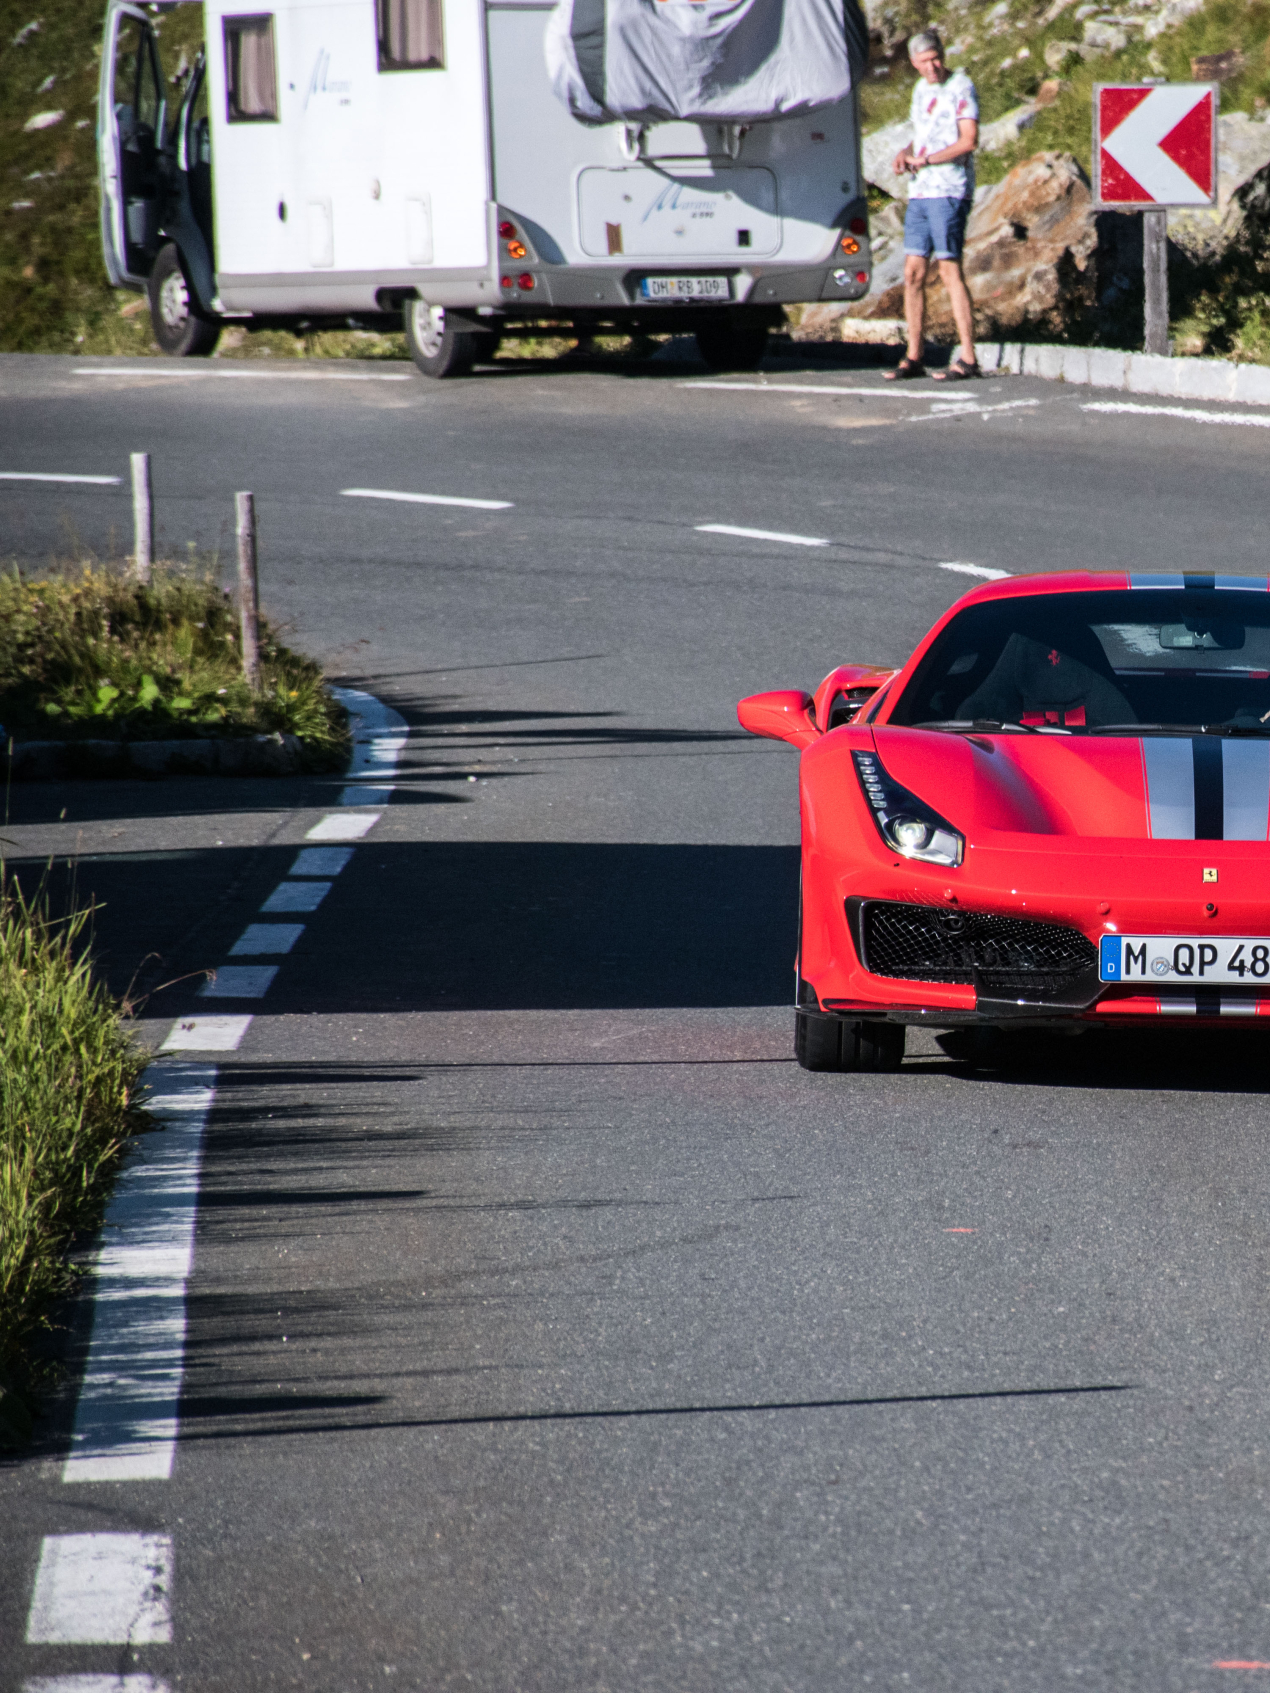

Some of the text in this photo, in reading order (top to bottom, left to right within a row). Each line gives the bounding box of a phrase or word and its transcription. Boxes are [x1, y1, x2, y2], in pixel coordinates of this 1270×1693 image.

[697, 280, 720, 295] 109
[1124, 942, 1147, 975] M
[1172, 943, 1218, 976] QP
[1107, 962, 1116, 973] D
